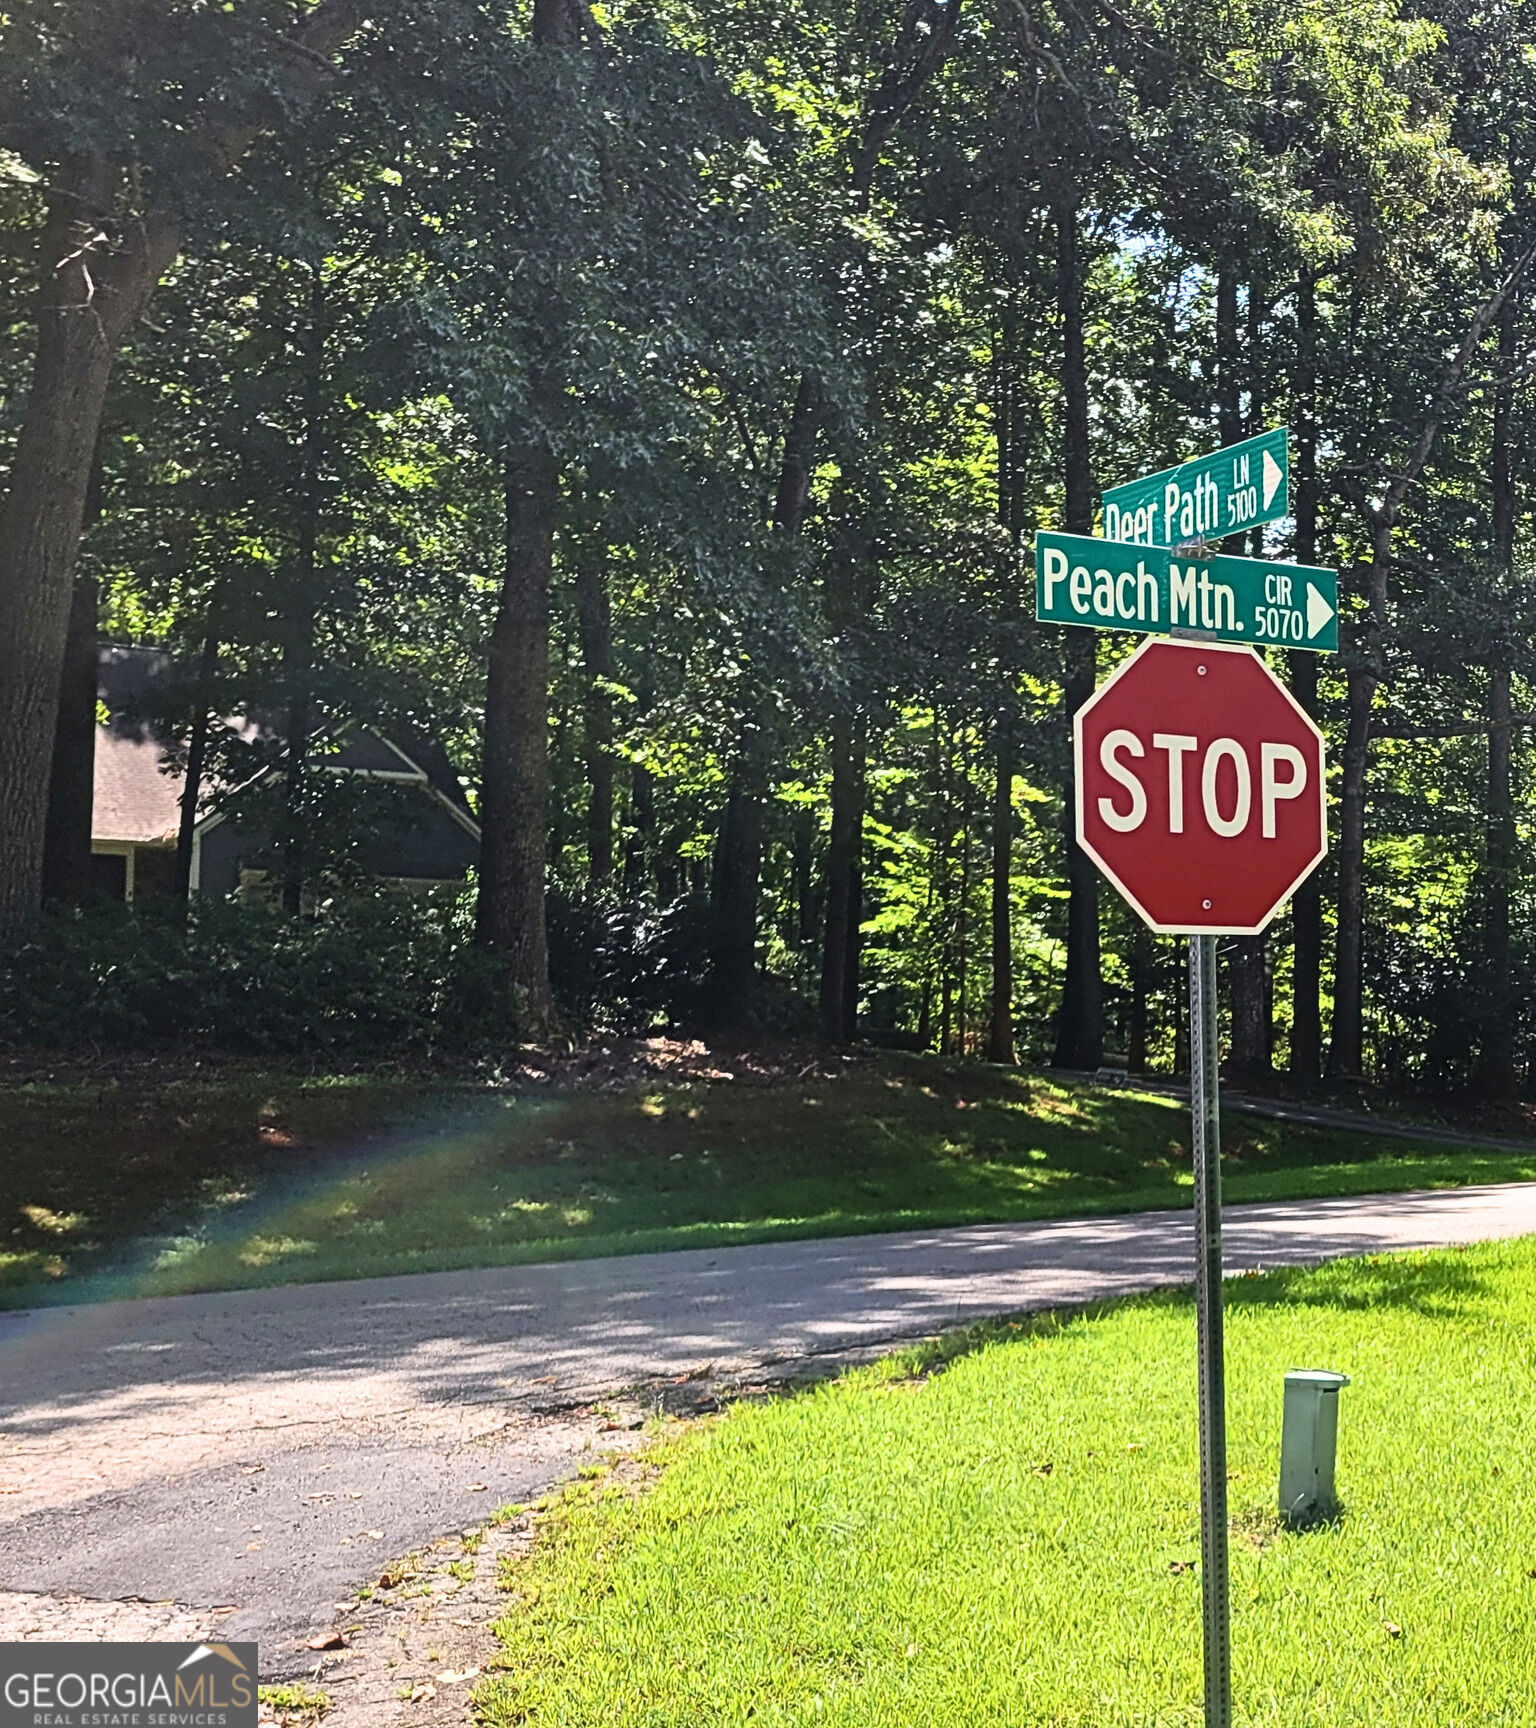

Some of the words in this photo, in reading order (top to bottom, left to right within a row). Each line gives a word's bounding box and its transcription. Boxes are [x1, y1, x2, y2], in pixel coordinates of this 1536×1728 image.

[1233, 453, 1250, 489] LN
[1106, 502, 1157, 546] Deer
[1165, 471, 1218, 543] Path
[1227, 486, 1257, 527] 5100
[1043, 548, 1158, 622] Peach
[1169, 565, 1244, 632] Mtn.
[1265, 574, 1292, 606] CIR
[1255, 606, 1303, 641] 5070
[1098, 729, 1307, 839] STOP
